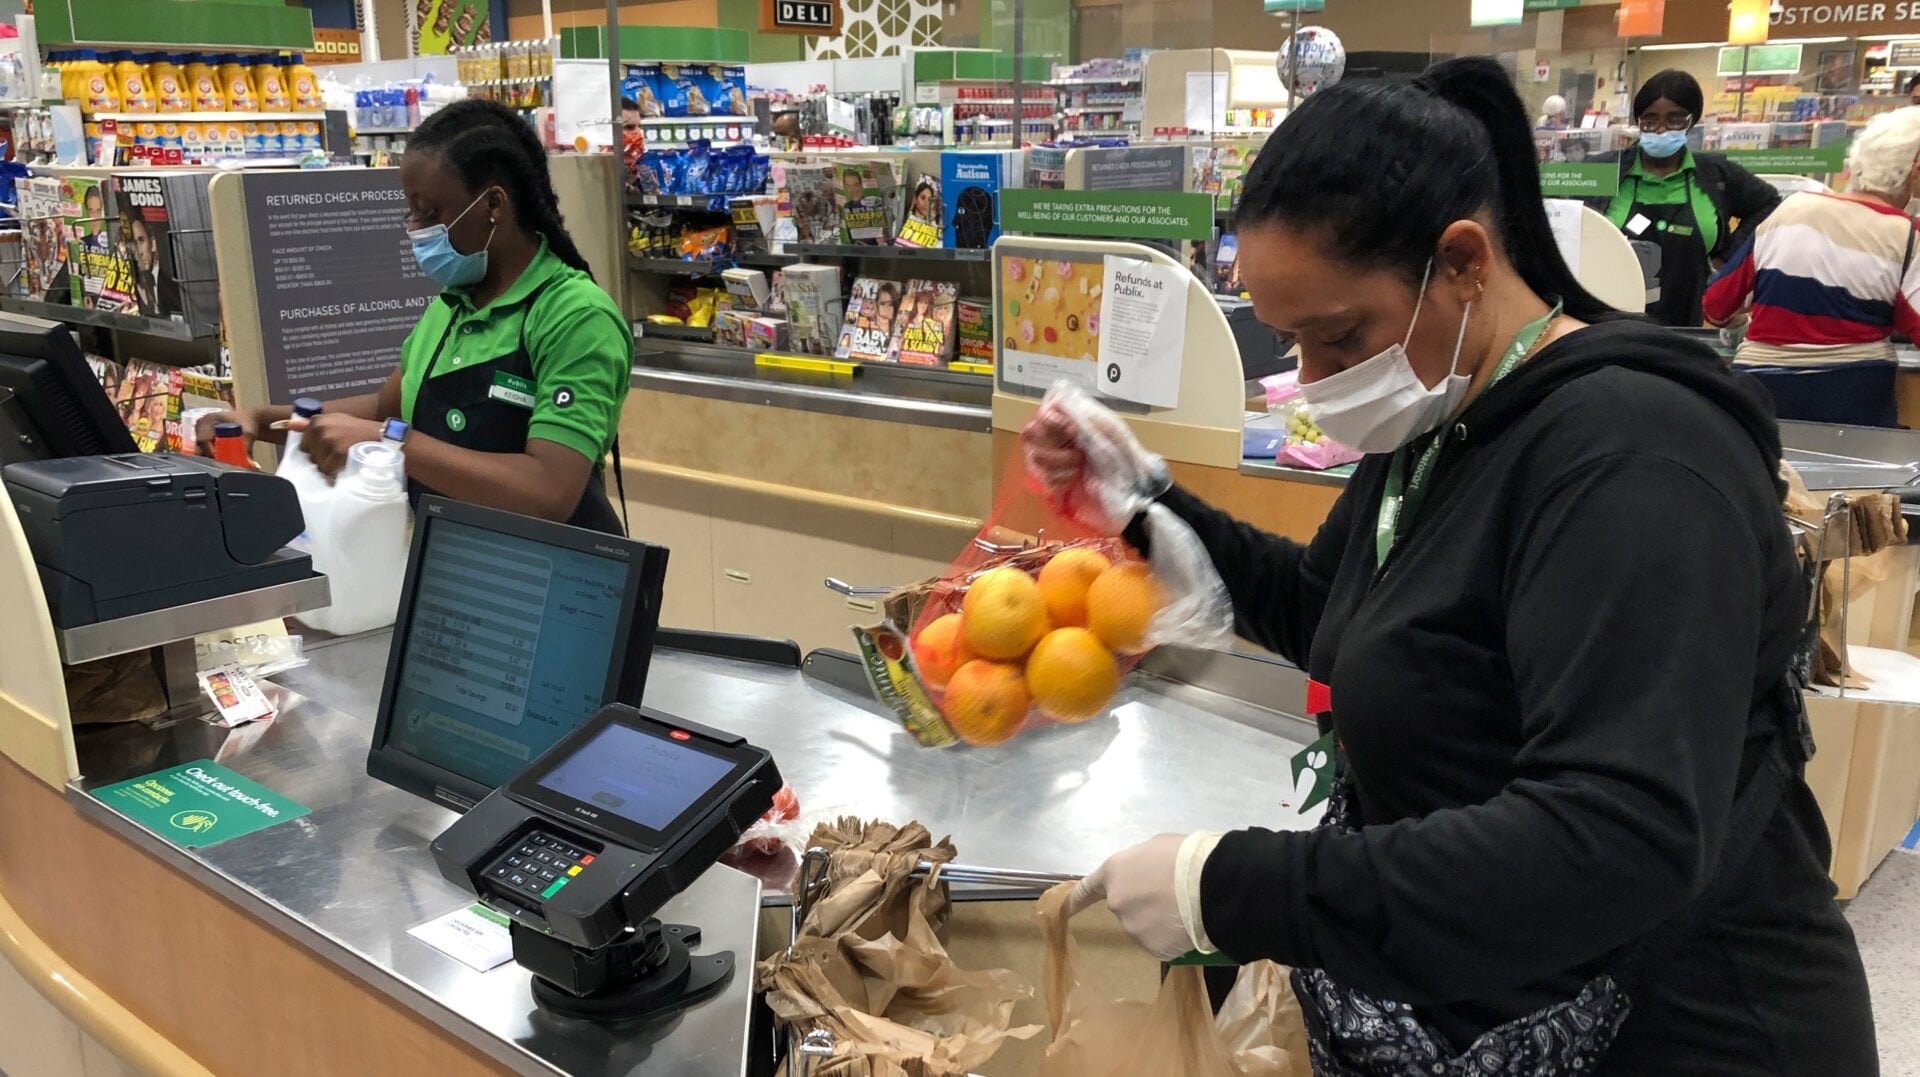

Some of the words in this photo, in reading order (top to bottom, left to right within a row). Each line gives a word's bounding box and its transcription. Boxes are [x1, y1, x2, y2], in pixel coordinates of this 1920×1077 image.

[783, 4, 828, 22] DELI
[316, 43, 359, 54] KERY
[956, 169, 990, 180] Autism
[122, 179, 162, 193] JAMES
[130, 193, 164, 207] BOND
[266, 193, 323, 206] RETURNED
[324, 191, 360, 204] CHECK
[1033, 202, 1051, 210] WE'RE
[1052, 203, 1074, 212] TAKING
[1075, 204, 1095, 212] EXTRA
[1096, 204, 1141, 214] PRECAUTIONS
[1142, 205, 1156, 214] FOR
[1158, 206, 1171, 215] THE
[1018, 212, 1051, 220] WELL-BEING
[1052, 212, 1061, 220] OF
[1062, 212, 1075, 221] OUR
[1076, 213, 1114, 223] CUSTOMERS
[1115, 214, 1130, 223] AND
[1131, 215, 1146, 224] OUR
[1147, 216, 1189, 226] ASSOCIATES.
[1115, 271, 1152, 287] Refunds
[1152, 280, 1163, 290] at
[1113, 283, 1145, 299] Publix.
[280, 305, 341, 320] PURCHASES
[343, 303, 356, 314] OF
[358, 299, 403, 312] ALCOHOL
[405, 297, 425, 307] AND
[507, 378, 527, 389] Publix
[1410, 447, 1433, 490] instacart
[428, 504, 444, 514] NEC
[185, 766, 217, 786] Check
[214, 781, 234, 795] out
[228, 788, 281, 819] touch-free.
